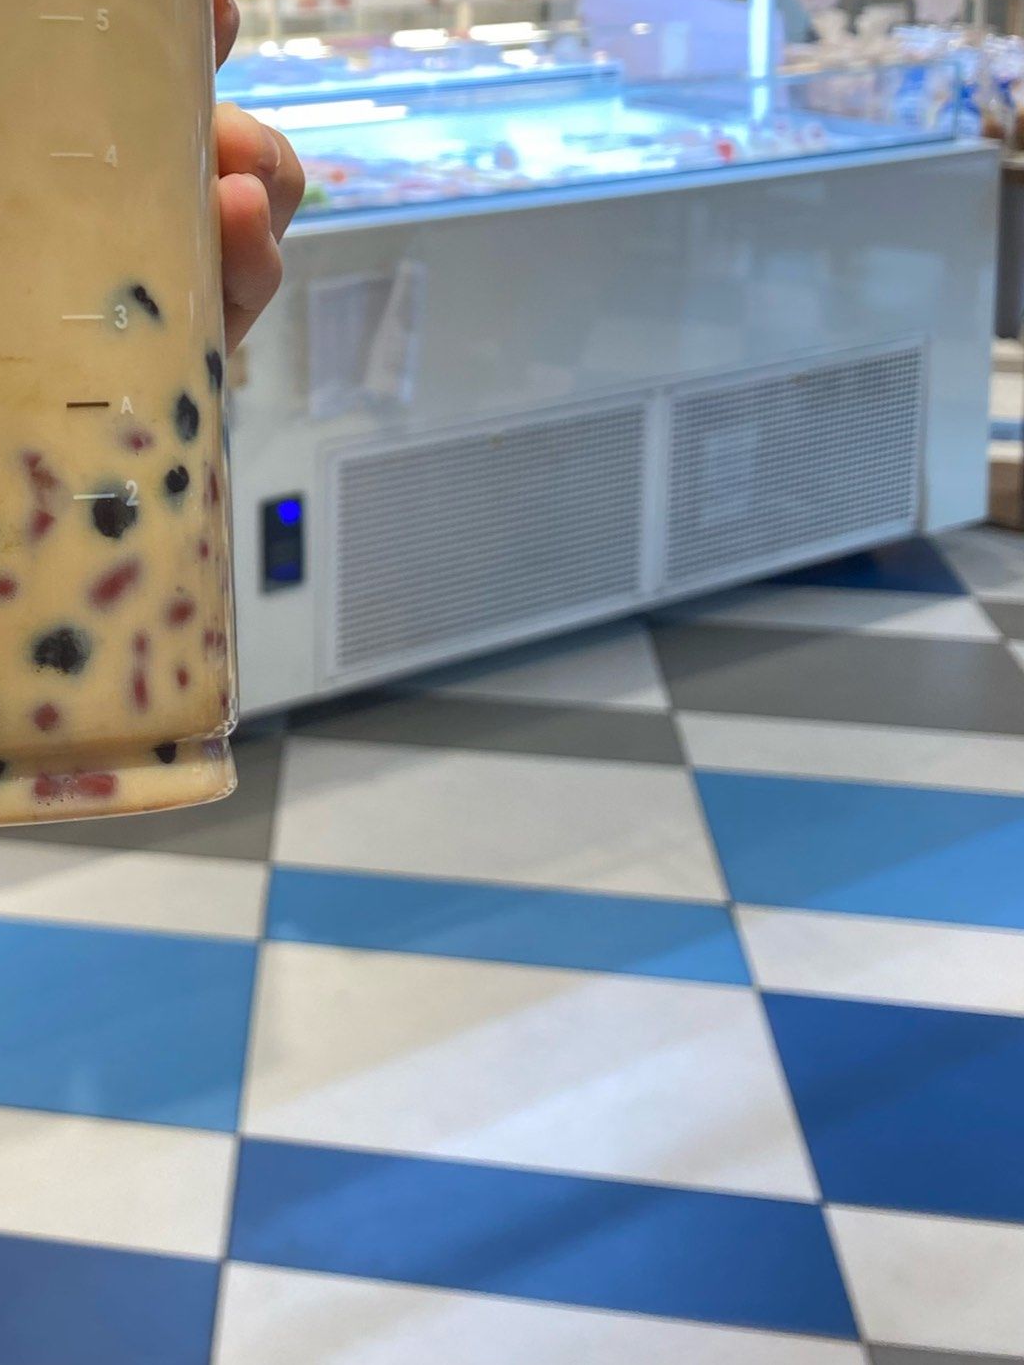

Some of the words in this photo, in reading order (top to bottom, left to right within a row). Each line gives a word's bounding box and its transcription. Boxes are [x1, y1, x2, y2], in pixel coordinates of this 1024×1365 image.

[96, 8, 109, 31] 5
[104, 145, 118, 167] 4
[114, 305, 128, 329] 3
[120, 396, 134, 414] A
[125, 480, 139, 507] 2
